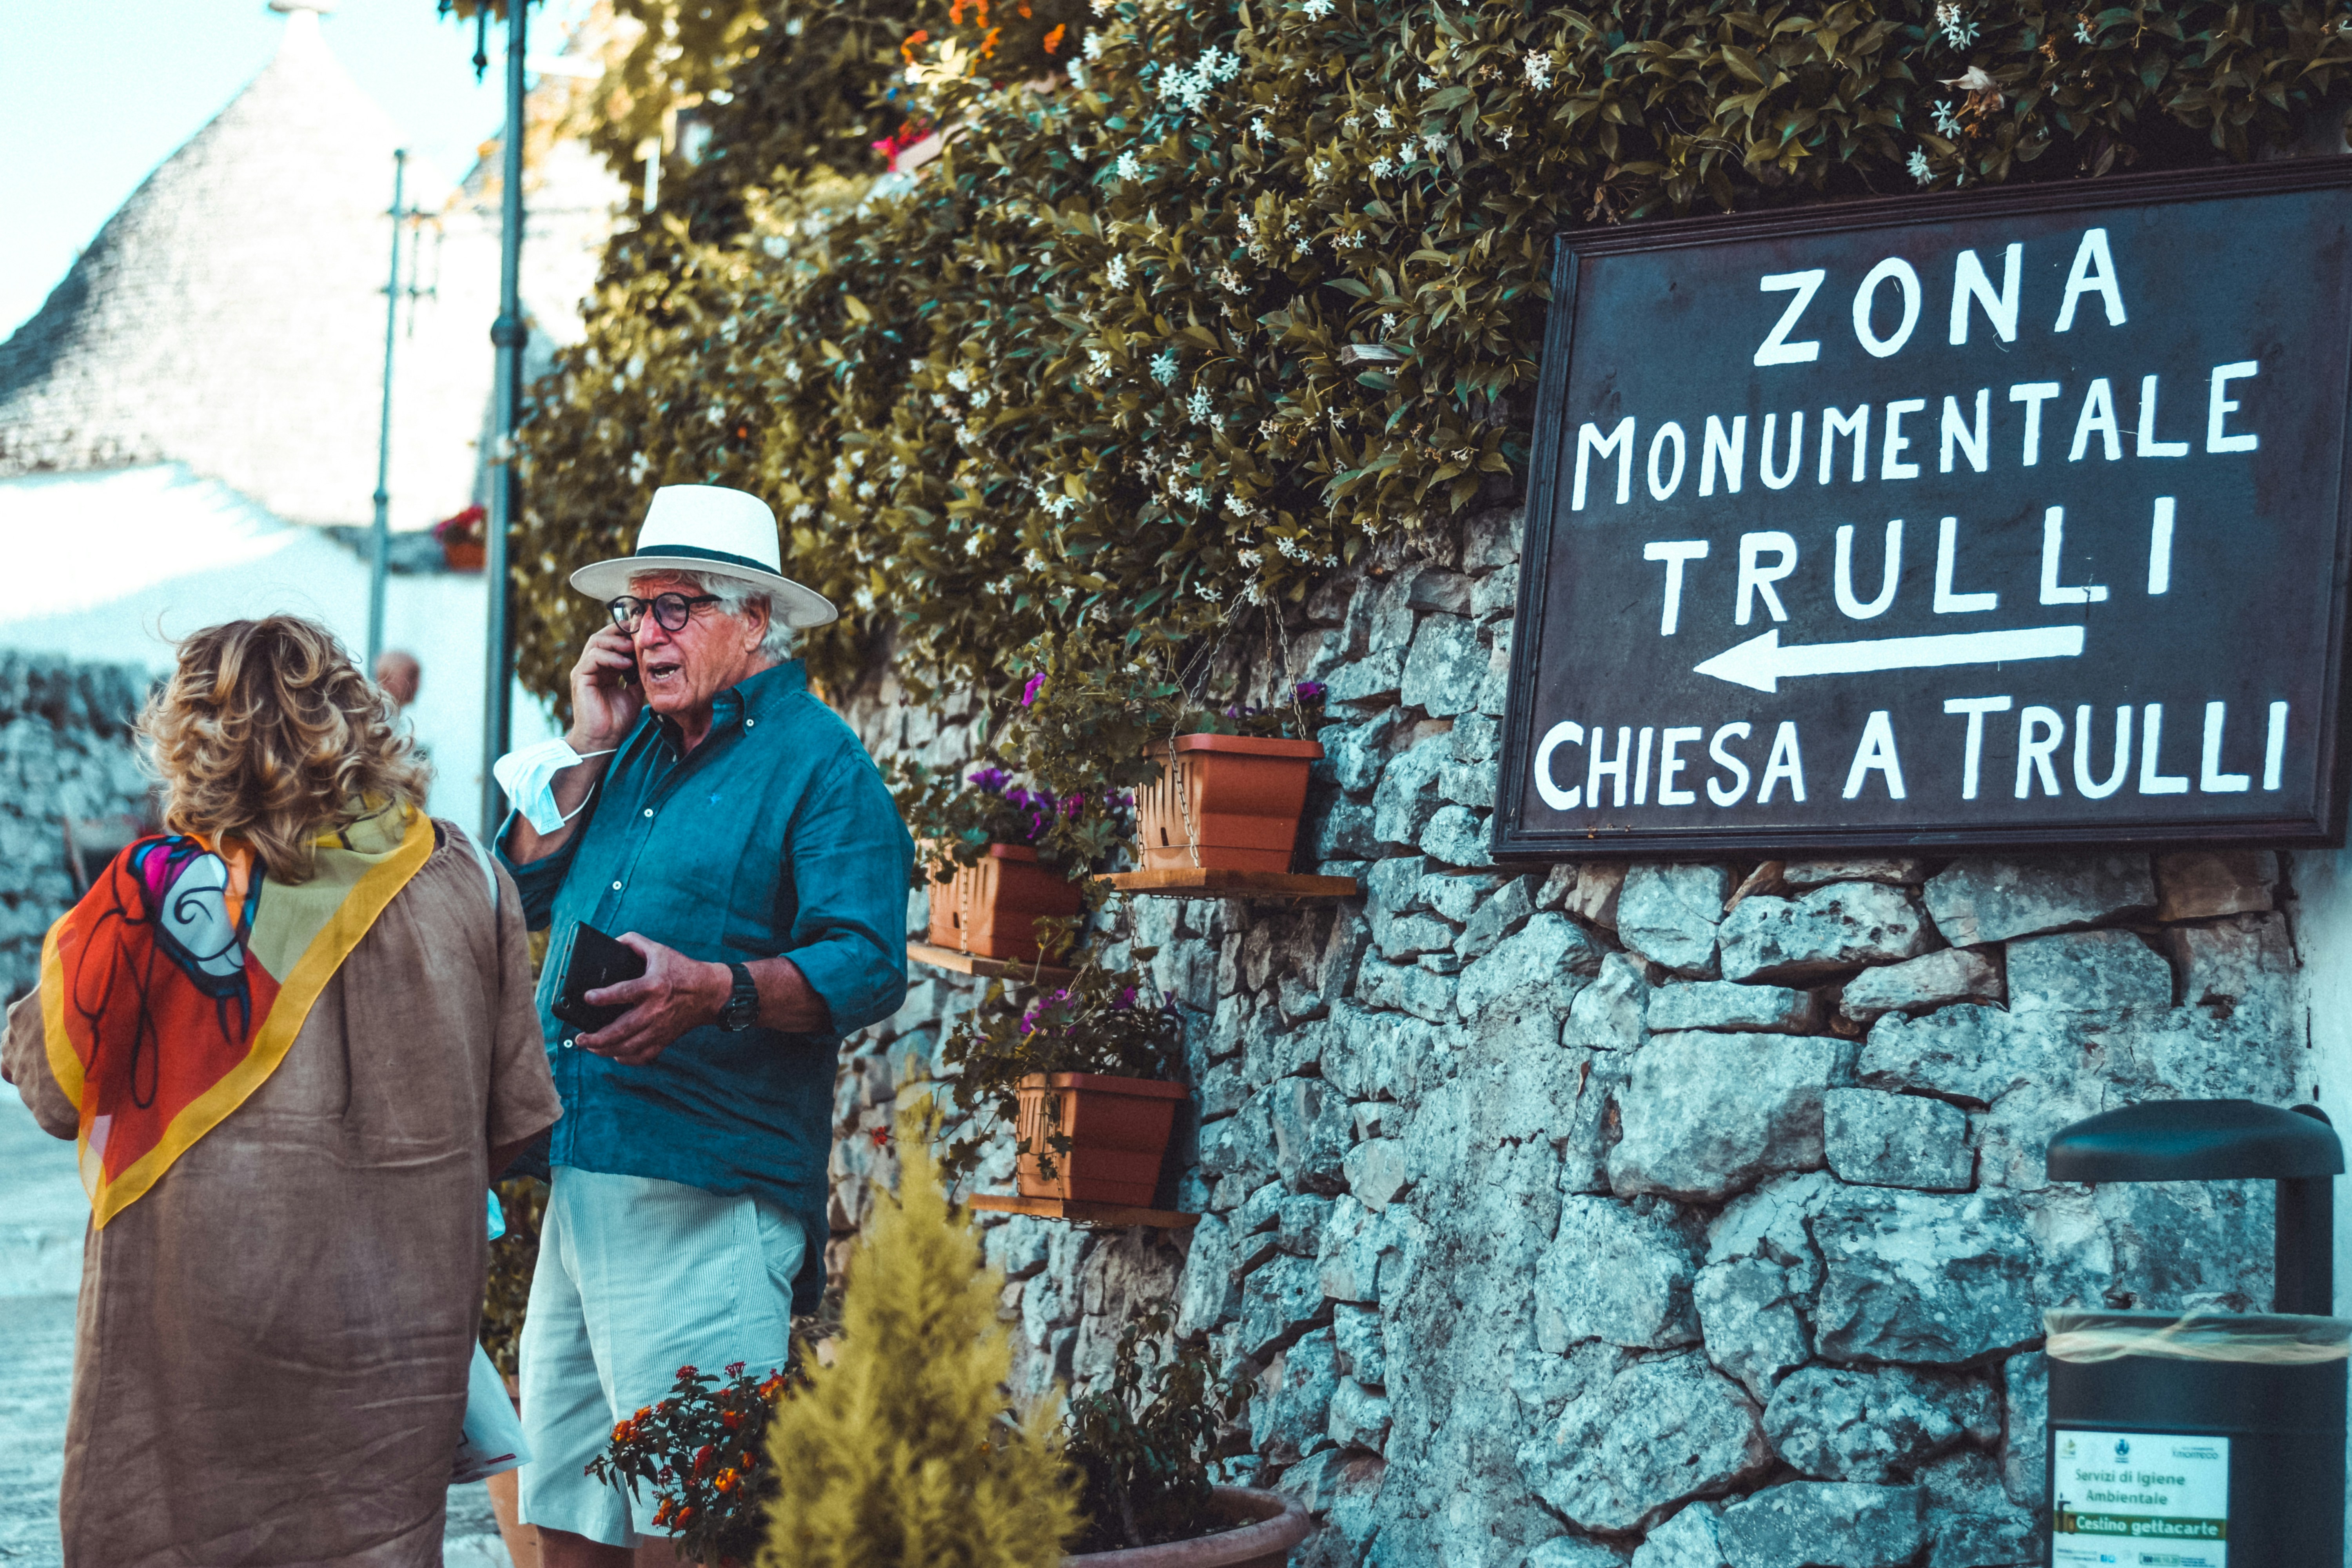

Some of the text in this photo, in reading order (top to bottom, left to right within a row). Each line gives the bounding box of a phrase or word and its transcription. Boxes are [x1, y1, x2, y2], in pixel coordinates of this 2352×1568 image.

[1754, 228, 2126, 366] ZONA
[1572, 361, 2259, 511] MONUMENTALE
[1644, 497, 2175, 636] TRULLI
[1534, 696, 2288, 811] CHIESA A TRULLI
[2075, 1469, 2185, 1487] Servizi di Igiene
[2077, 1516, 2219, 1535] Cestino gettacarte
[2086, 1490, 2168, 1505] Ambientale
